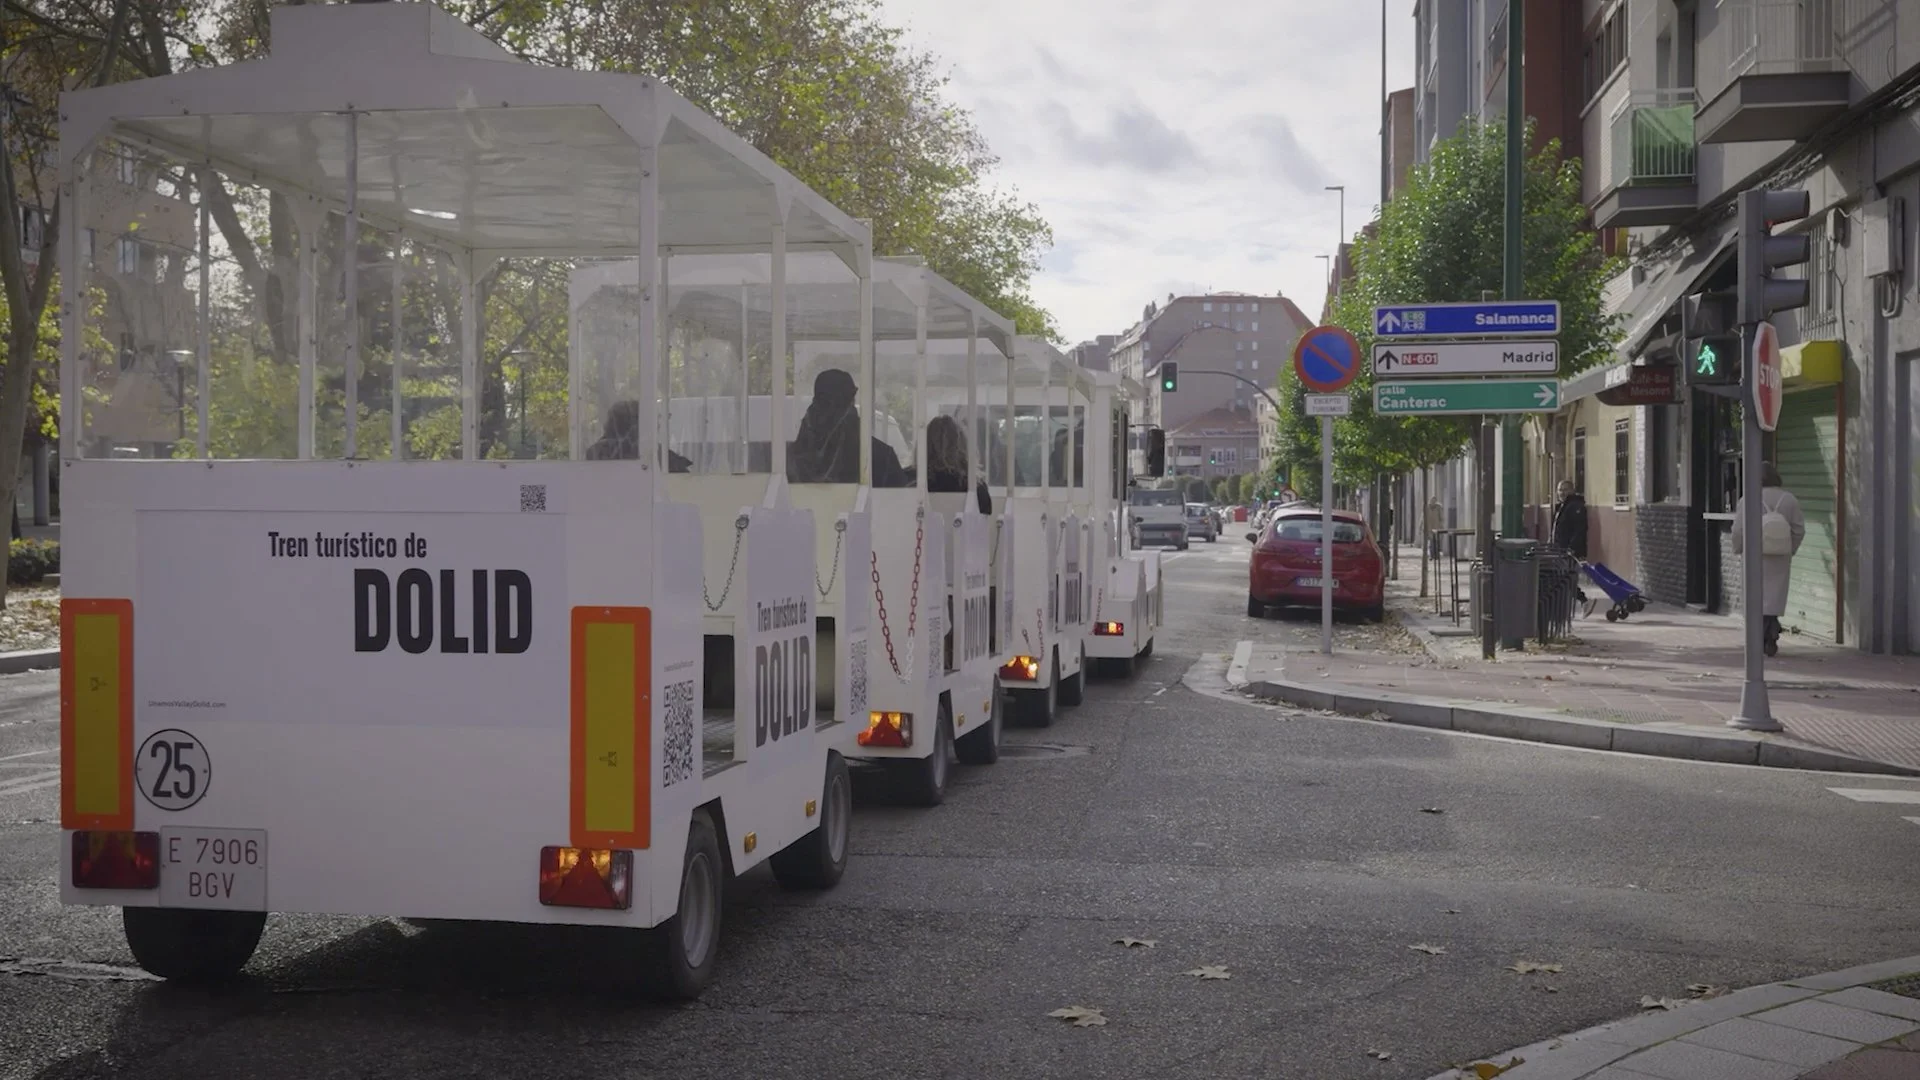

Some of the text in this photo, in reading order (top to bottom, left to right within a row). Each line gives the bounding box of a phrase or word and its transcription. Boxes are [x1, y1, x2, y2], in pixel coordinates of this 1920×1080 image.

[1475, 313, 1555, 326] Salamanca
[1402, 350, 1554, 365] N-601 Madrid
[1380, 396, 1447, 408] Canterac
[268, 531, 427, 558] Tren turístico de
[354, 568, 533, 654] DOLID
[757, 597, 807, 632] Tren turístico de
[755, 635, 810, 748] DOLID
[150, 740, 196, 799] 25
[169, 837, 258, 865] E 7906
[189, 871, 235, 898] BGV
